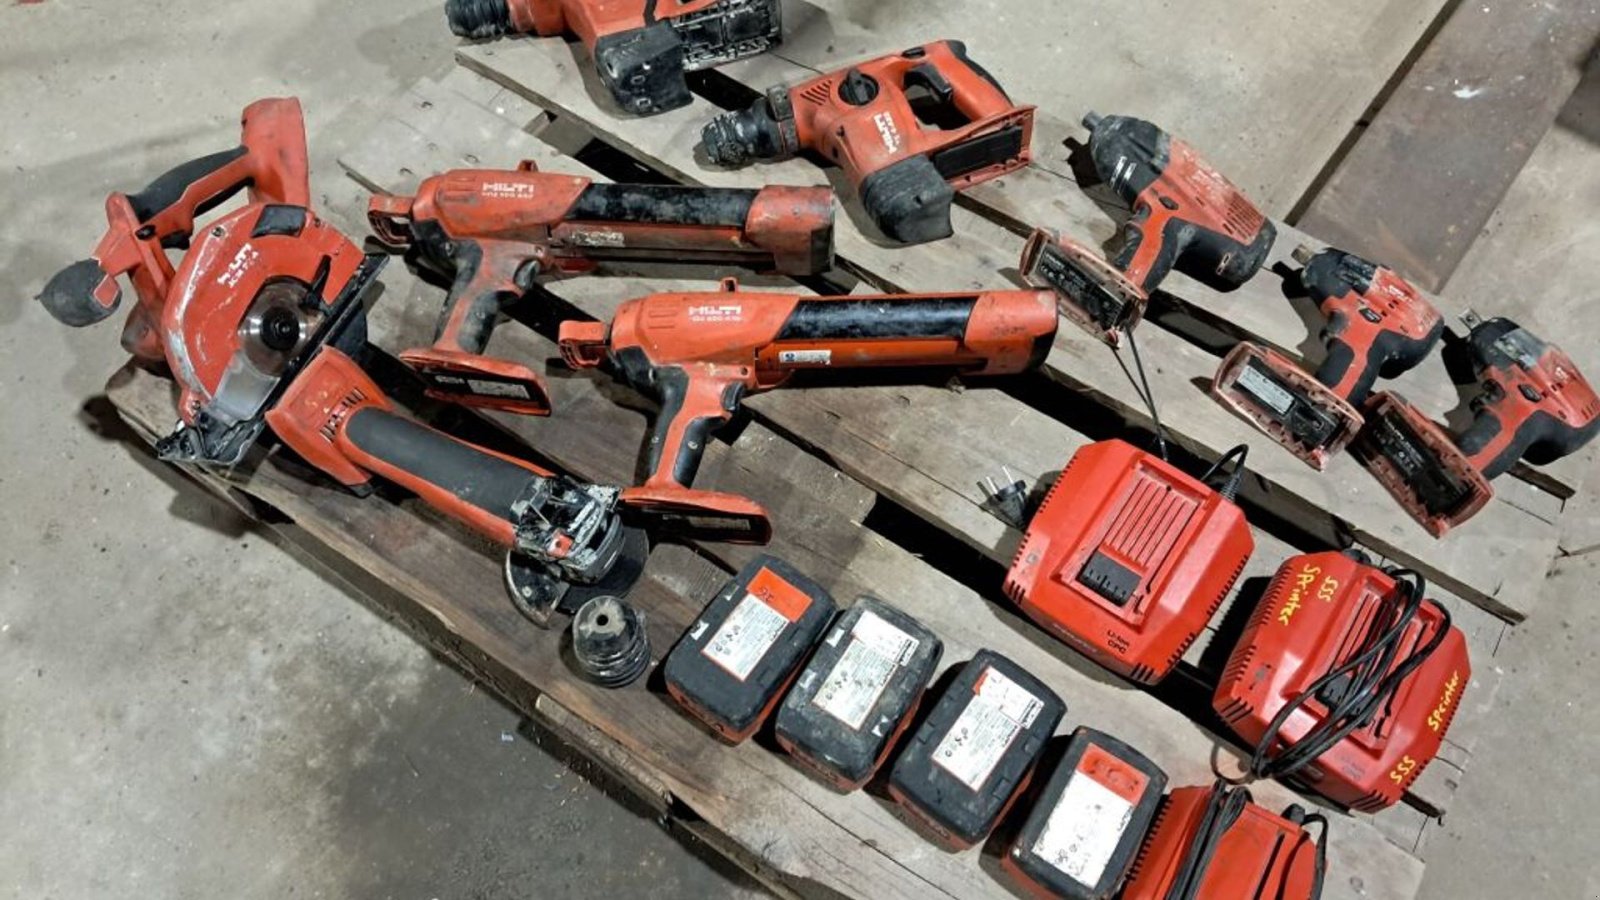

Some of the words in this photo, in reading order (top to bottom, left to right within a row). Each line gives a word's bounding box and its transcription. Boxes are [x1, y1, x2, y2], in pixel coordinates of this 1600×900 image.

[482, 182, 534, 192] HILTI
[688, 305, 742, 315] HILTI
[1317, 576, 1339, 603] SSS
[1390, 755, 1416, 785] SSS
